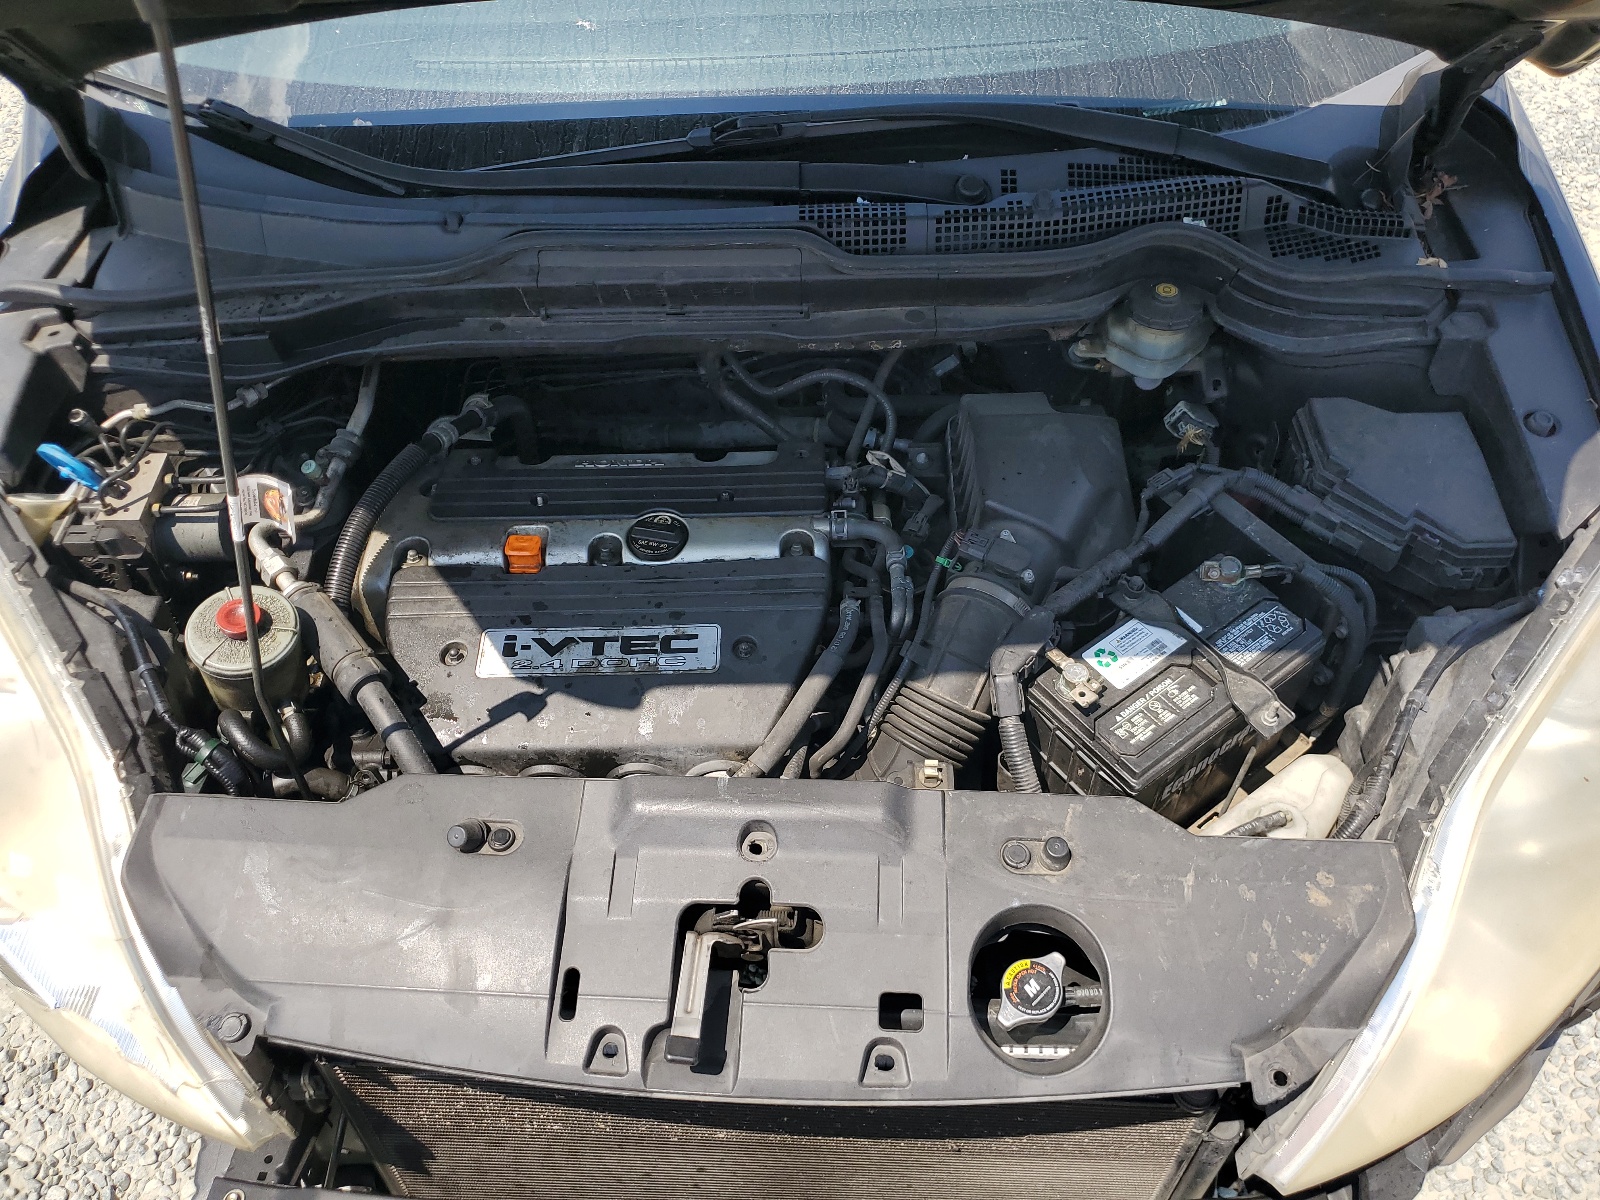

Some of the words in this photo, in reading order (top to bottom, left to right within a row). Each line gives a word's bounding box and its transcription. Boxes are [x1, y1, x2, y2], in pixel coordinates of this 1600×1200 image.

[502, 633, 699, 658] i-VTEC
[511, 658, 563, 670] 2.4
[571, 656, 686, 669] DOHC
[1120, 697, 1146, 718] DANGER
[1149, 677, 1174, 697] POISON
[1006, 962, 1029, 981] CAUTION
[1023, 977, 1041, 998] M
